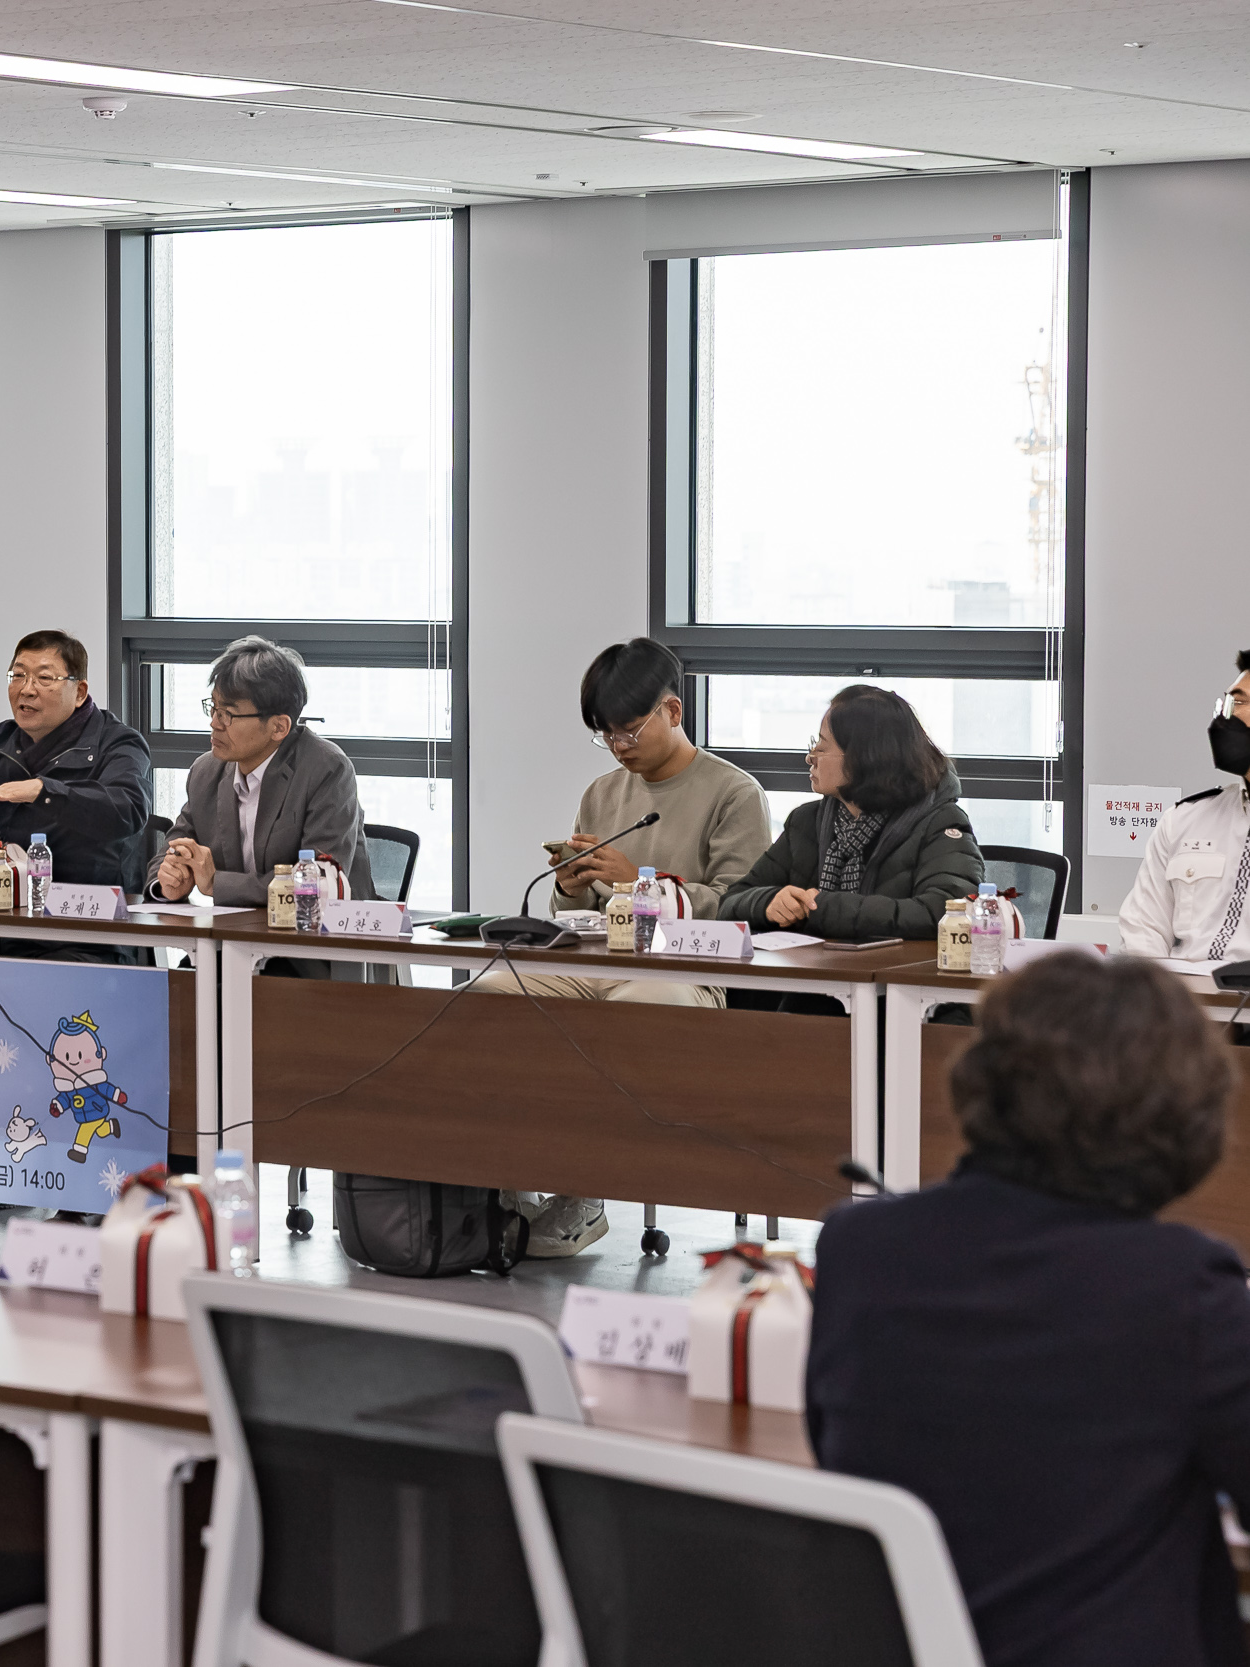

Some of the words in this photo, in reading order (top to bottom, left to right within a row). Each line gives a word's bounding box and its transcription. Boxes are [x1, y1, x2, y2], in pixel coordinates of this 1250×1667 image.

[1105, 800, 1140, 812] 물건적재
[1144, 802, 1163, 813] 금지
[1109, 816, 1126, 827] 방송
[1131, 816, 1158, 828] 단자함
[338, 917, 382, 932] 이찬호
[21, 1168, 66, 1192] 14:00
